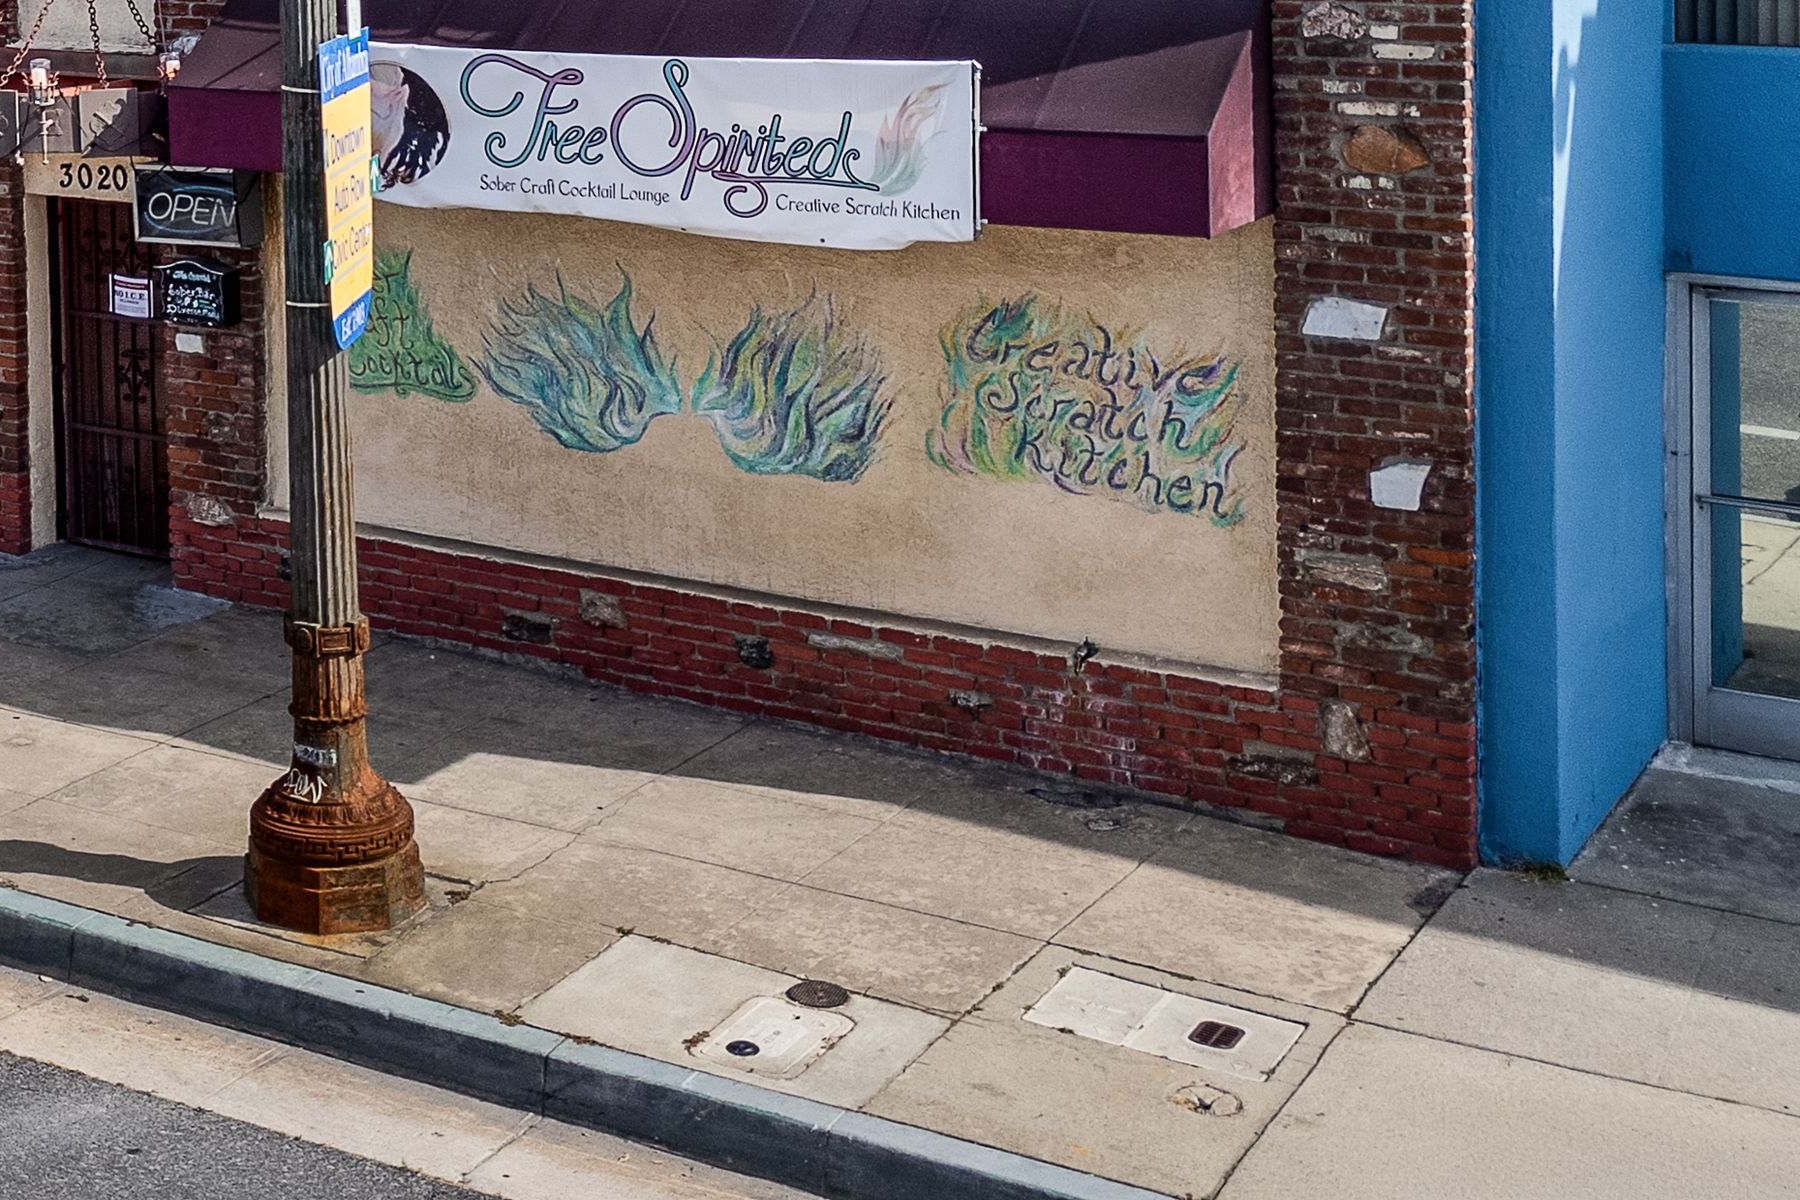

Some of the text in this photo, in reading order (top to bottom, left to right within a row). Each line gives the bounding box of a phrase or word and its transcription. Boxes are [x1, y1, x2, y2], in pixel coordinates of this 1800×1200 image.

[330, 126, 365, 165] Downtown
[610, 58, 880, 219] Spirited
[59, 162, 128, 191] 3020
[334, 174, 365, 213] Auto Row
[480, 173, 670, 206] Sober Craft Cocktail Lounge
[149, 192, 237, 227] OPEN
[775, 194, 960, 220] Creative Scratch Kitchen
[332, 222, 371, 271] Civic Center
[195, 287, 215, 300] Bar
[966, 306, 1225, 397] Creative
[986, 370, 1191, 450] Scratch
